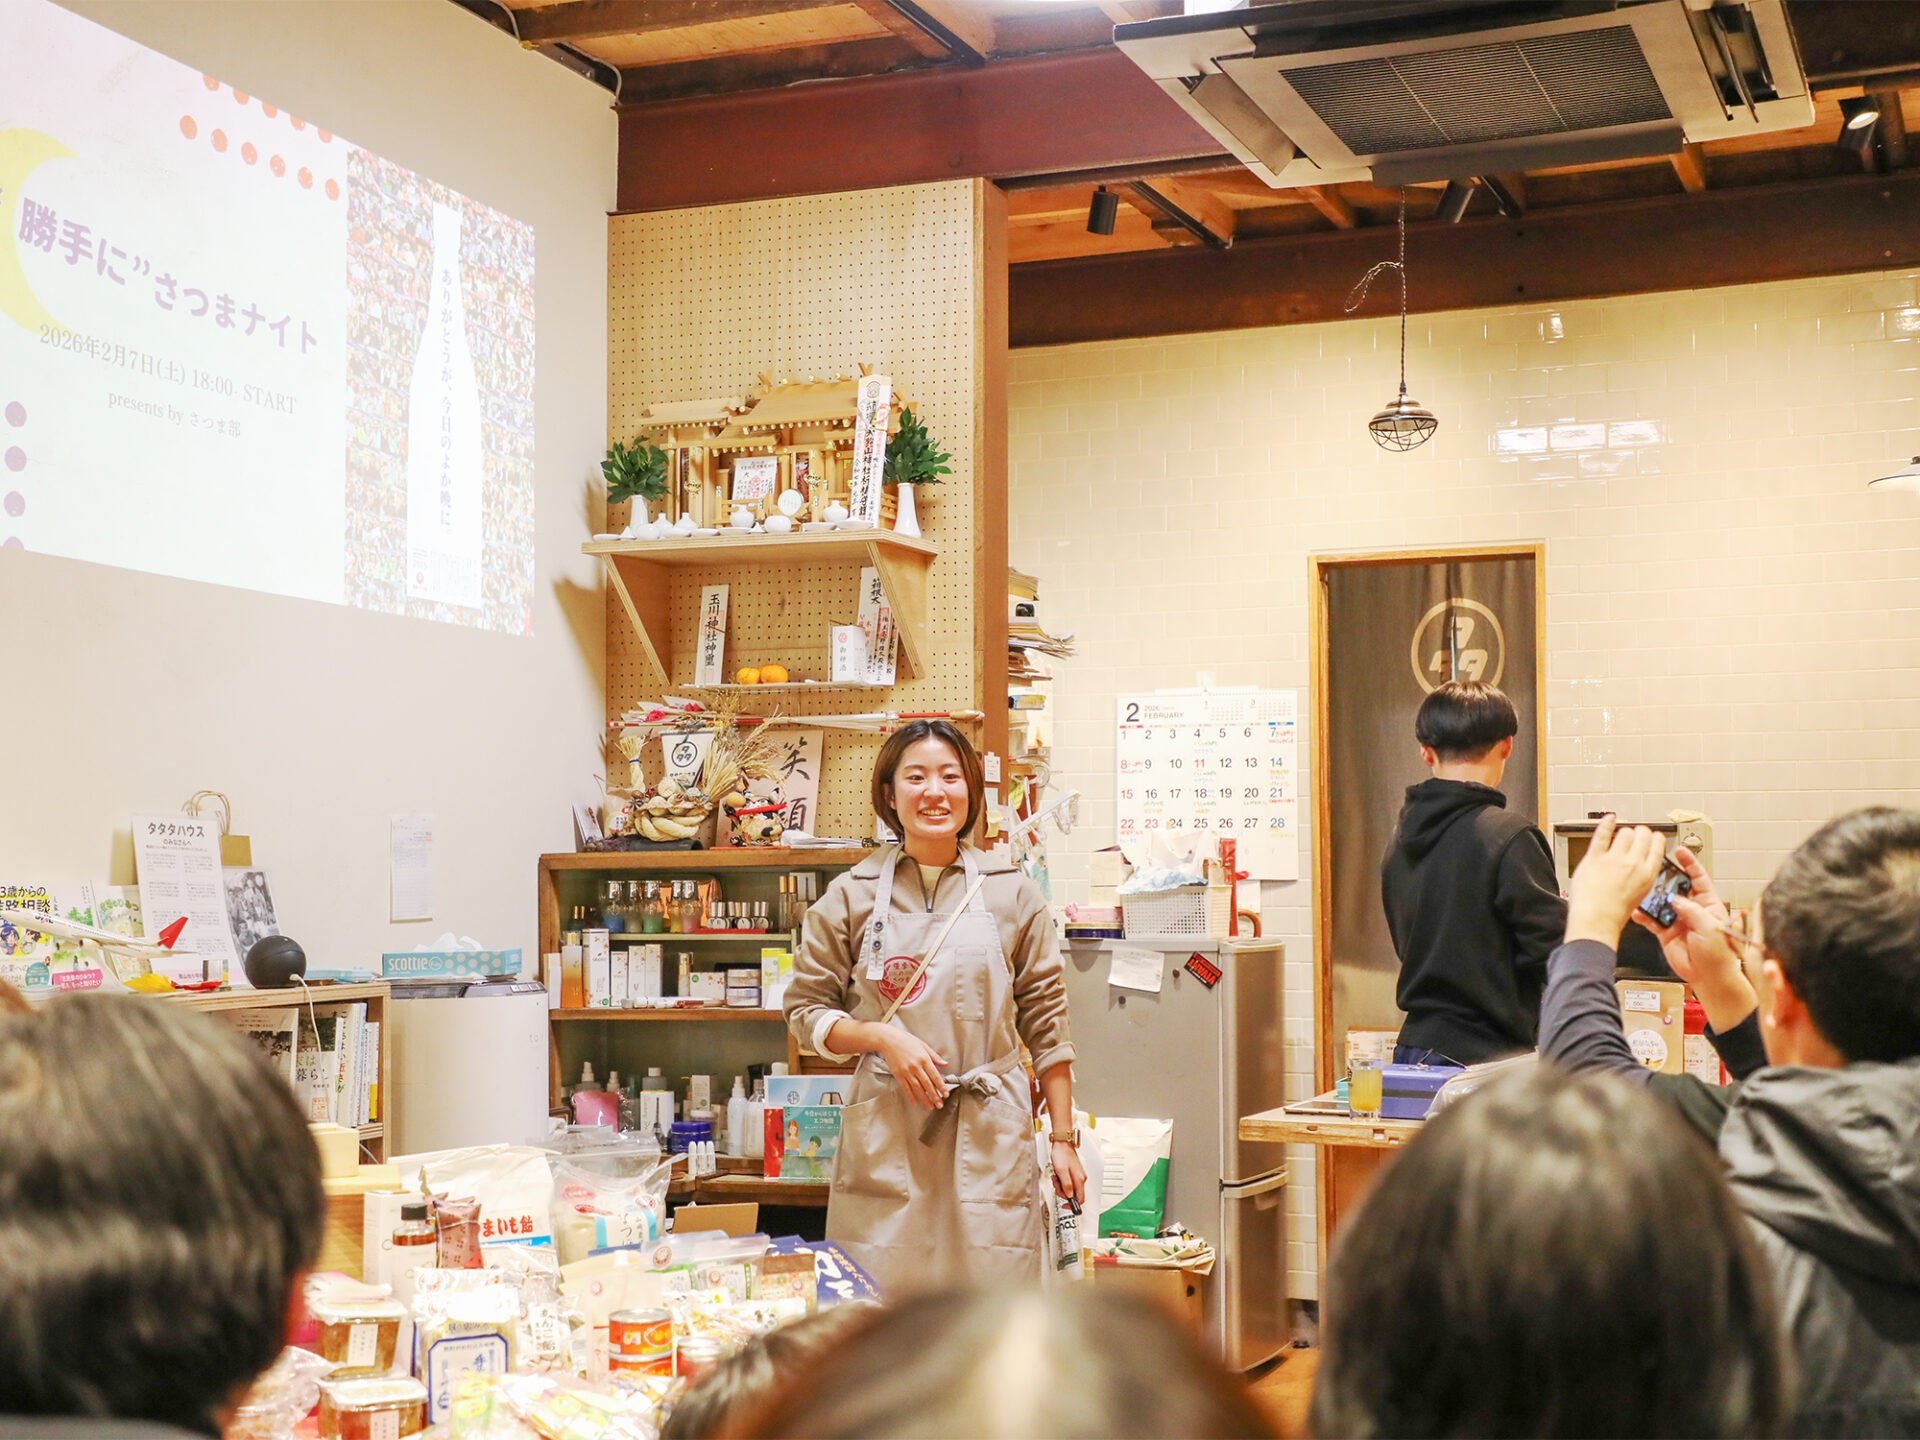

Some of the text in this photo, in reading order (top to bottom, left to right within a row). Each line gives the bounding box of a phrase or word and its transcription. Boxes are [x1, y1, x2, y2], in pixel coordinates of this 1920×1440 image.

[40, 323, 186, 384] 2026年2月7日(土)
[243, 384, 297, 414] START
[108, 392, 241, 438] presents by さつま部
[1126, 702, 1140, 722] 2
[1144, 712, 1184, 720] FEBRUARY
[1122, 727, 1276, 740] 1 2 3 4 5 6 7
[1120, 757, 1283, 769] 8 9 10 11 12 13 14
[1121, 788, 1283, 799] 15 16 17 18 19 20 21
[148, 822, 204, 837] タタタハウス
[1120, 817, 1285, 829] 22 23 24 25 26 27 28
[388, 957, 428, 971] scottie
[1187, 958, 1217, 985] VIVANT
[478, 1215, 533, 1237] まいも飴
